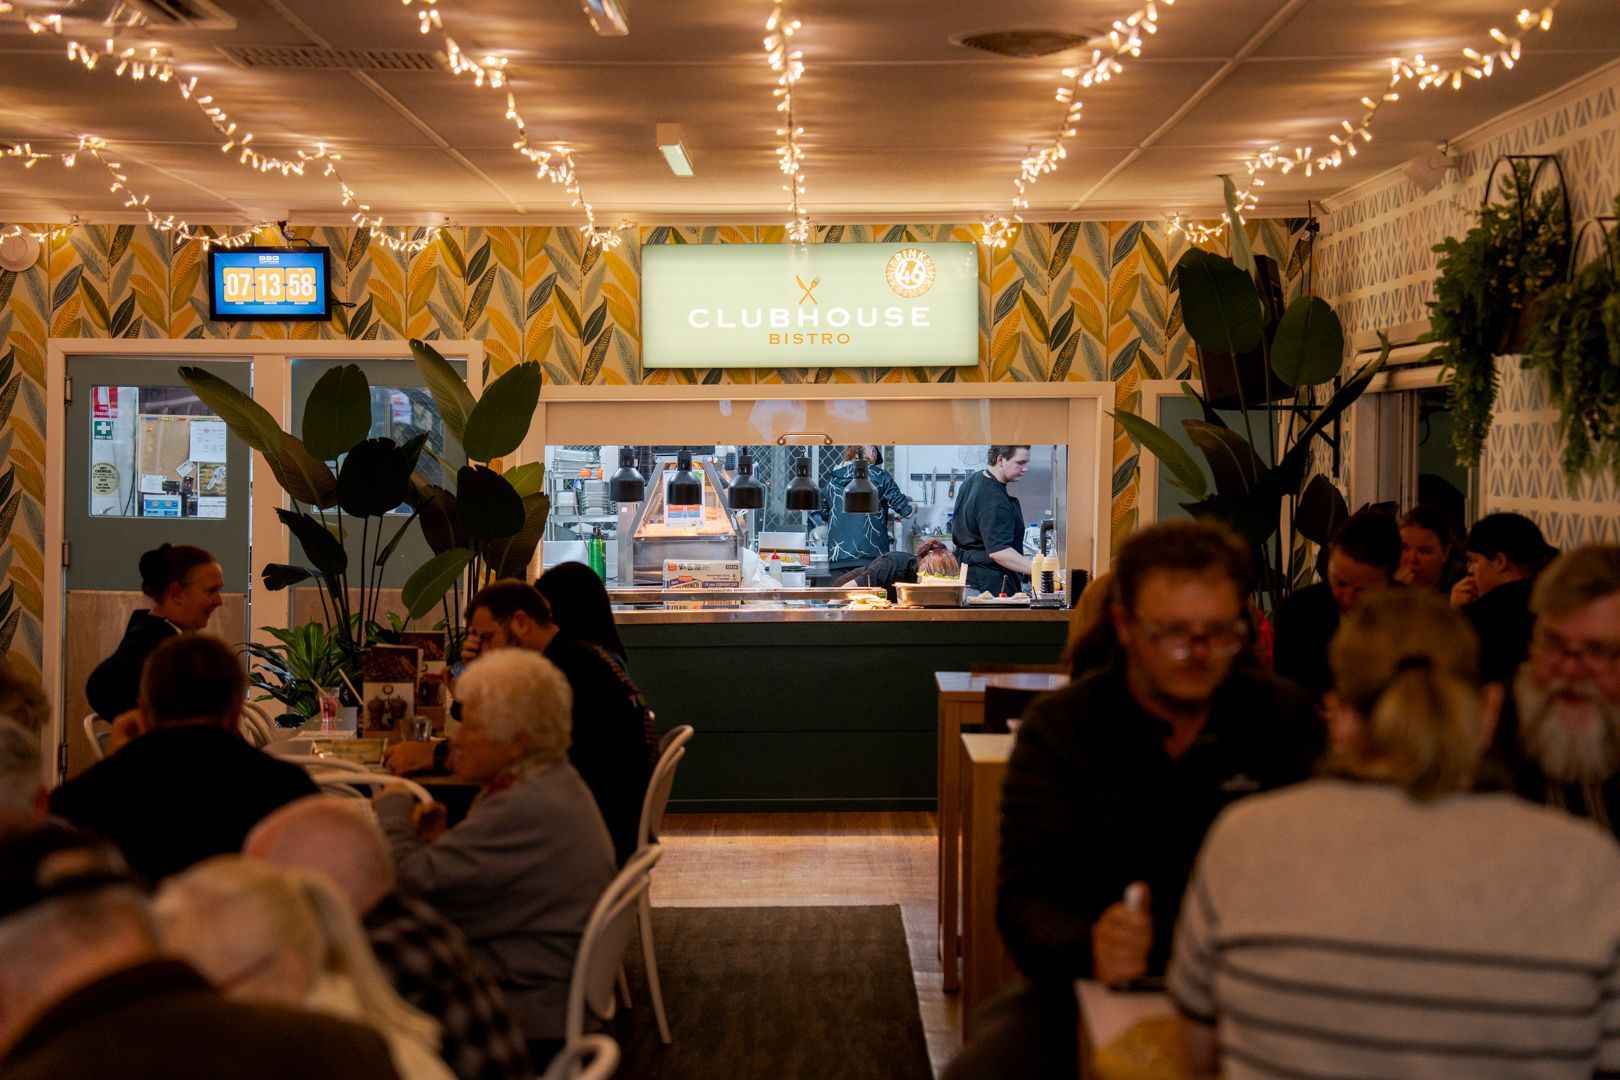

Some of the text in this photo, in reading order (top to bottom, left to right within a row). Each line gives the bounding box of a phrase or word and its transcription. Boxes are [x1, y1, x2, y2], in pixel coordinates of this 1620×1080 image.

[899, 261, 924, 284] 46
[226, 273, 313, 296] 07 13 58
[688, 306, 931, 328] CLUBHOUSE
[768, 333, 851, 345] BISTRO
